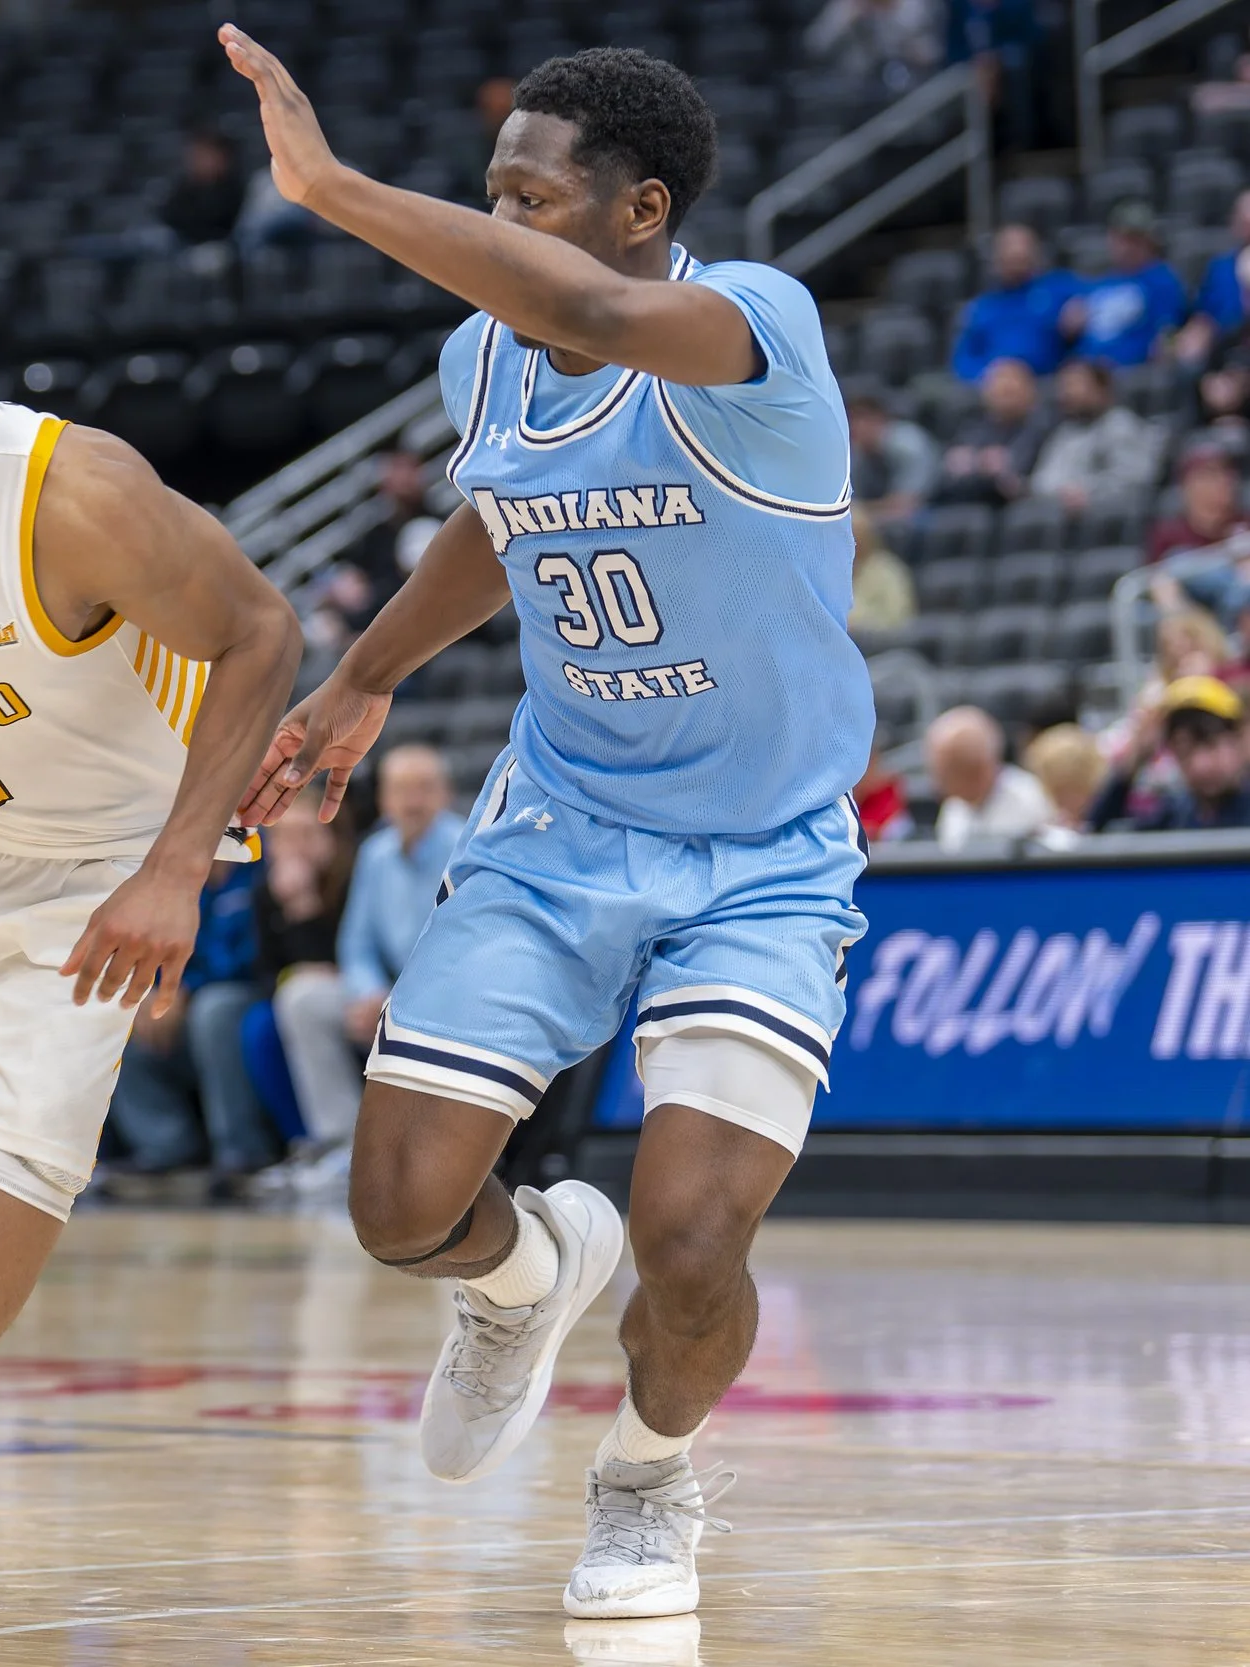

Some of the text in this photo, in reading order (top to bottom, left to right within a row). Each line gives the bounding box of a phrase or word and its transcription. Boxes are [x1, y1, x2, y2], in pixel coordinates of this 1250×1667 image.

[471, 485, 705, 555] INDIANA
[535, 548, 664, 650] 30
[563, 659, 719, 701] STATE
[851, 912, 1161, 1057] FOLLOW
